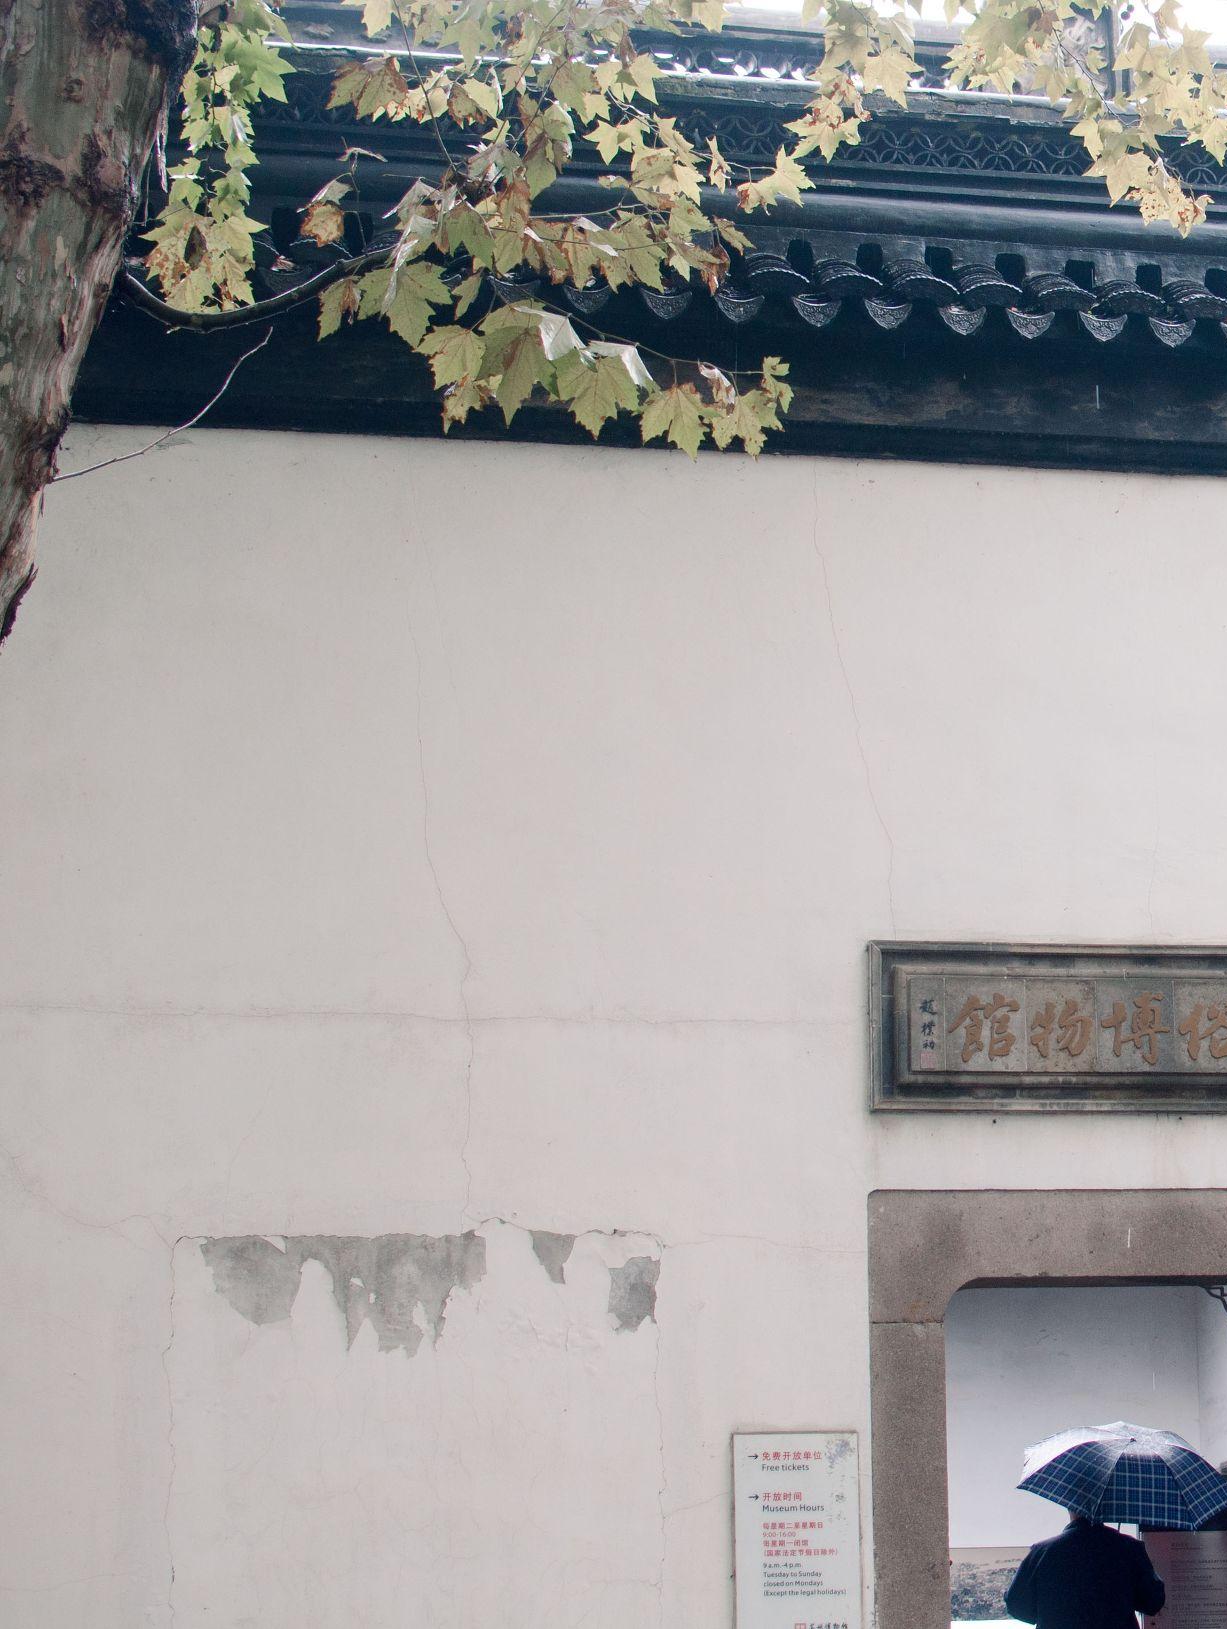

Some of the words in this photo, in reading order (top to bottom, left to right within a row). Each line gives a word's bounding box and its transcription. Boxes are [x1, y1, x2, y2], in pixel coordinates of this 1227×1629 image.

[762, 1451, 822, 1461] 免费开放单位
[761, 1463, 780, 1472] Free
[781, 1463, 810, 1472] tickets
[762, 1491, 803, 1502] 开放时间
[762, 1504, 798, 1513] Museum
[799, 1504, 825, 1512] Hours
[763, 1571, 789, 1579] Tuesday
[798, 1570, 822, 1578] Sunday
[763, 1580, 785, 1588] closed
[795, 1580, 823, 1588] Mondays
[763, 1590, 787, 1598] (Except
[788, 1589, 800, 1597] the
[800, 1589, 816, 1597] legal
[817, 1588, 847, 1597] holidays)
